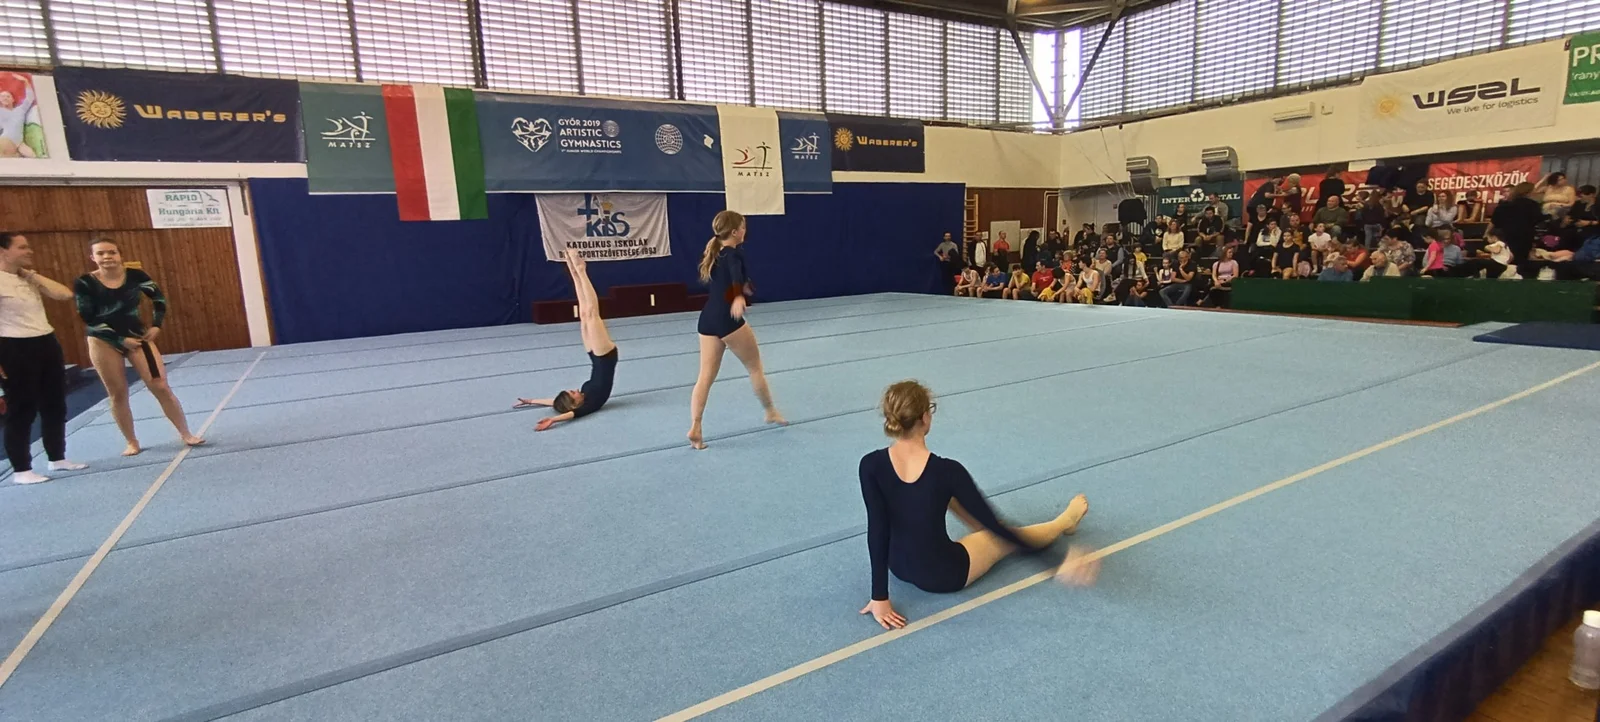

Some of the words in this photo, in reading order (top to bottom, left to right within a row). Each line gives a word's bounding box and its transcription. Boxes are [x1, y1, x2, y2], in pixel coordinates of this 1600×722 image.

[1464, 105, 1480, 113] live
[1482, 102, 1496, 110] for
[1498, 97, 1539, 109] logistics
[559, 128, 602, 137] ARTISTIC
[328, 141, 371, 149] MATSZ
[560, 139, 622, 148] GYMNASTICS
[1161, 196, 1191, 204] INTER
[1204, 193, 1241, 202] MTAL
[566, 240, 612, 249] KATOLIKUS
[614, 238, 649, 248] ISKOLÁK
[641, 247, 657, 255] 1993
